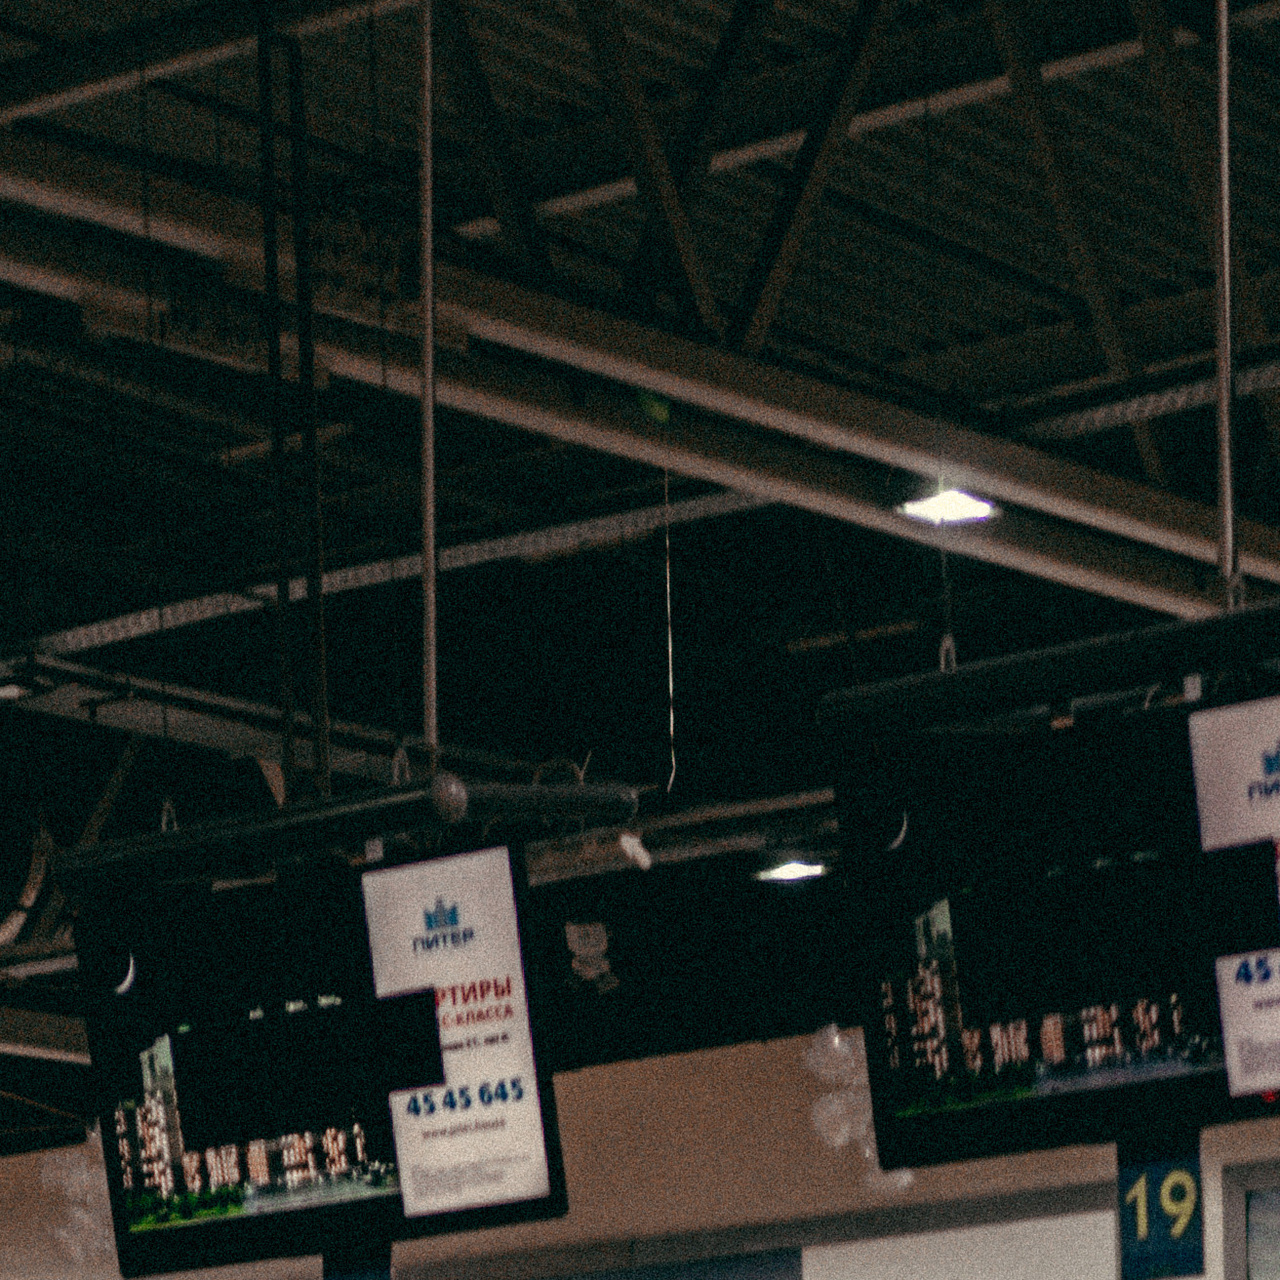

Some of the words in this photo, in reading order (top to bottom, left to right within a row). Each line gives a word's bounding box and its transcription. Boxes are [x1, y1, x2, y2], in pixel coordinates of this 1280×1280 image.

[412, 926, 475, 952] ПИТЕР
[1235, 956, 1272, 985] 45
[407, 1090, 436, 1116] 45
[442, 1085, 472, 1111] 45
[478, 1076, 524, 1107] 645
[1125, 1170, 1197, 1240] 19
